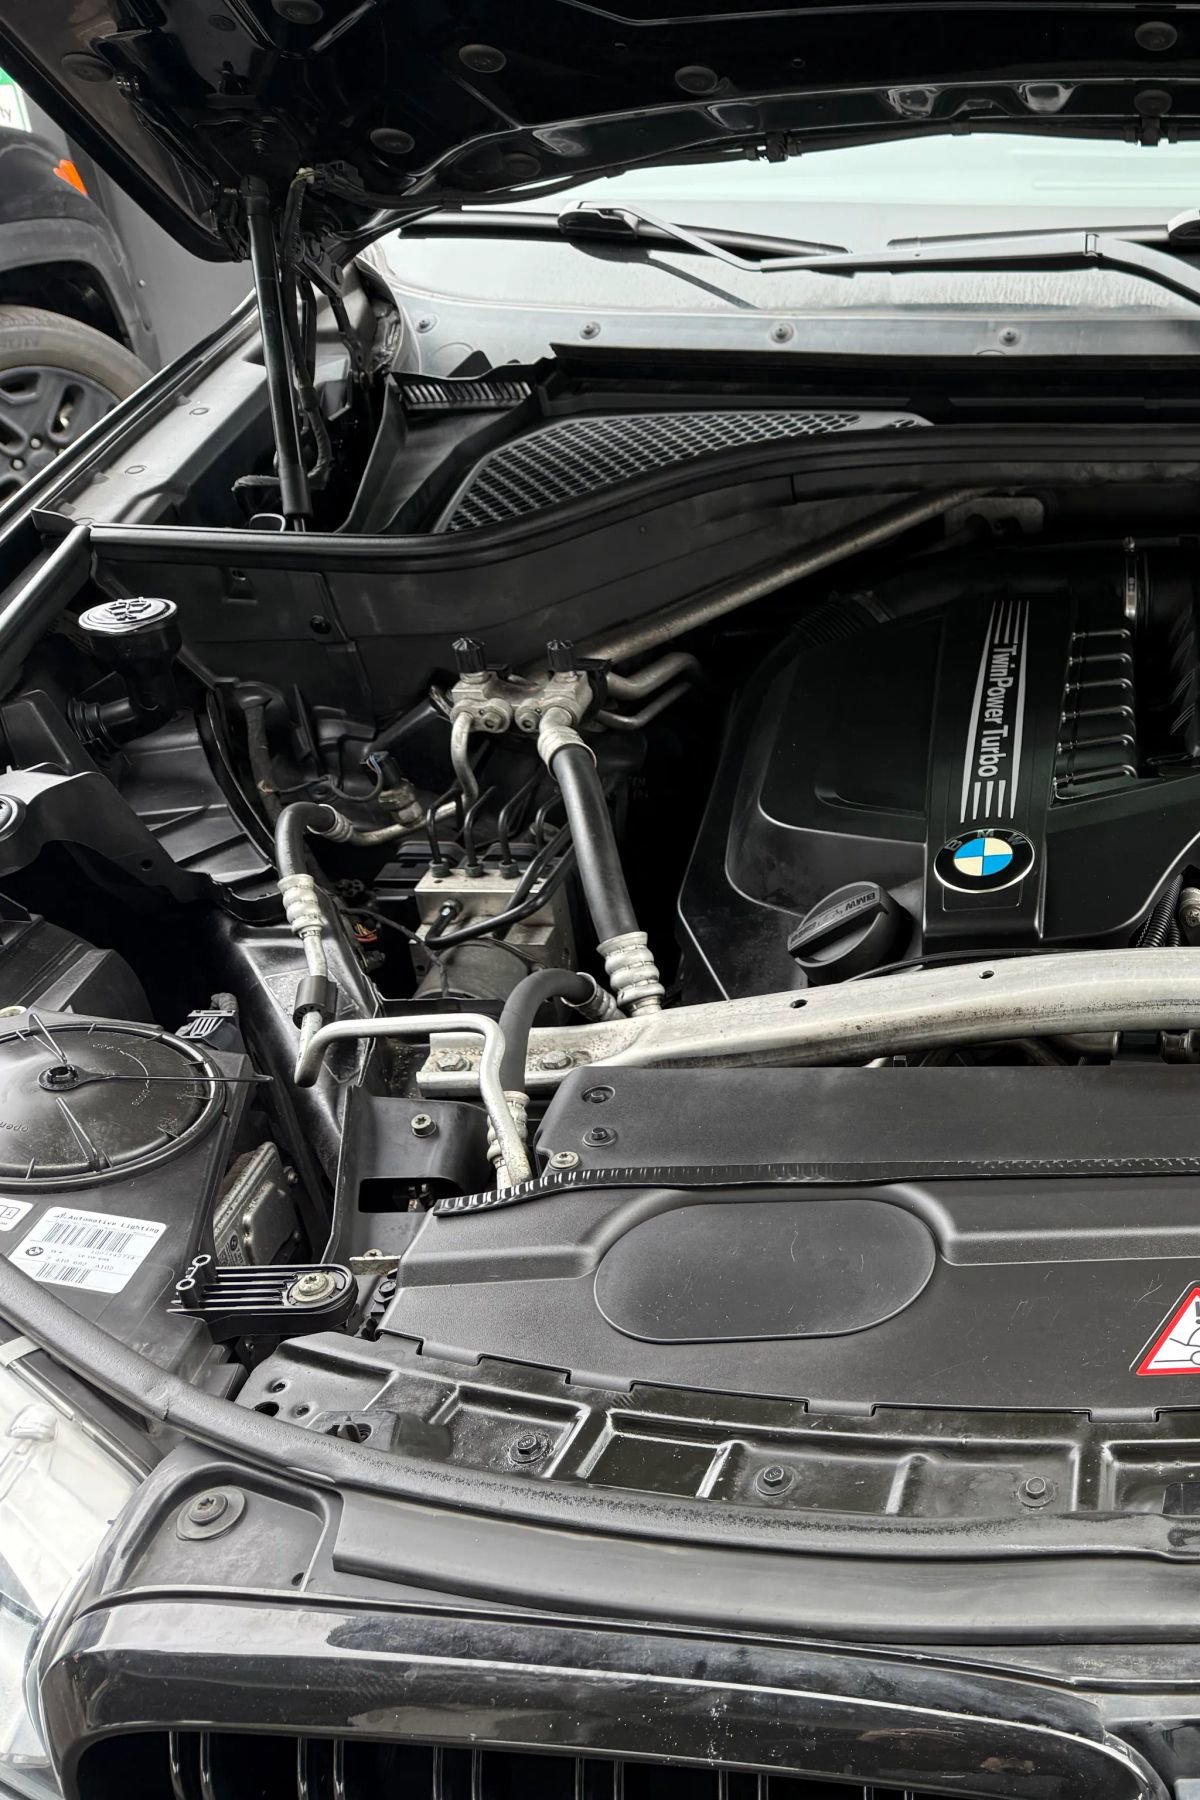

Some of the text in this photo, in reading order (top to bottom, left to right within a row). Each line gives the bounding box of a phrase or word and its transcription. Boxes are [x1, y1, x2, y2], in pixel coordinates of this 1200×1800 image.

[977, 642, 1018, 779] TwinPower Turbo
[944, 829, 1027, 851] BMW
[844, 891, 877, 913] BMW
[67, 1214, 160, 1234] Automotive Lighting
